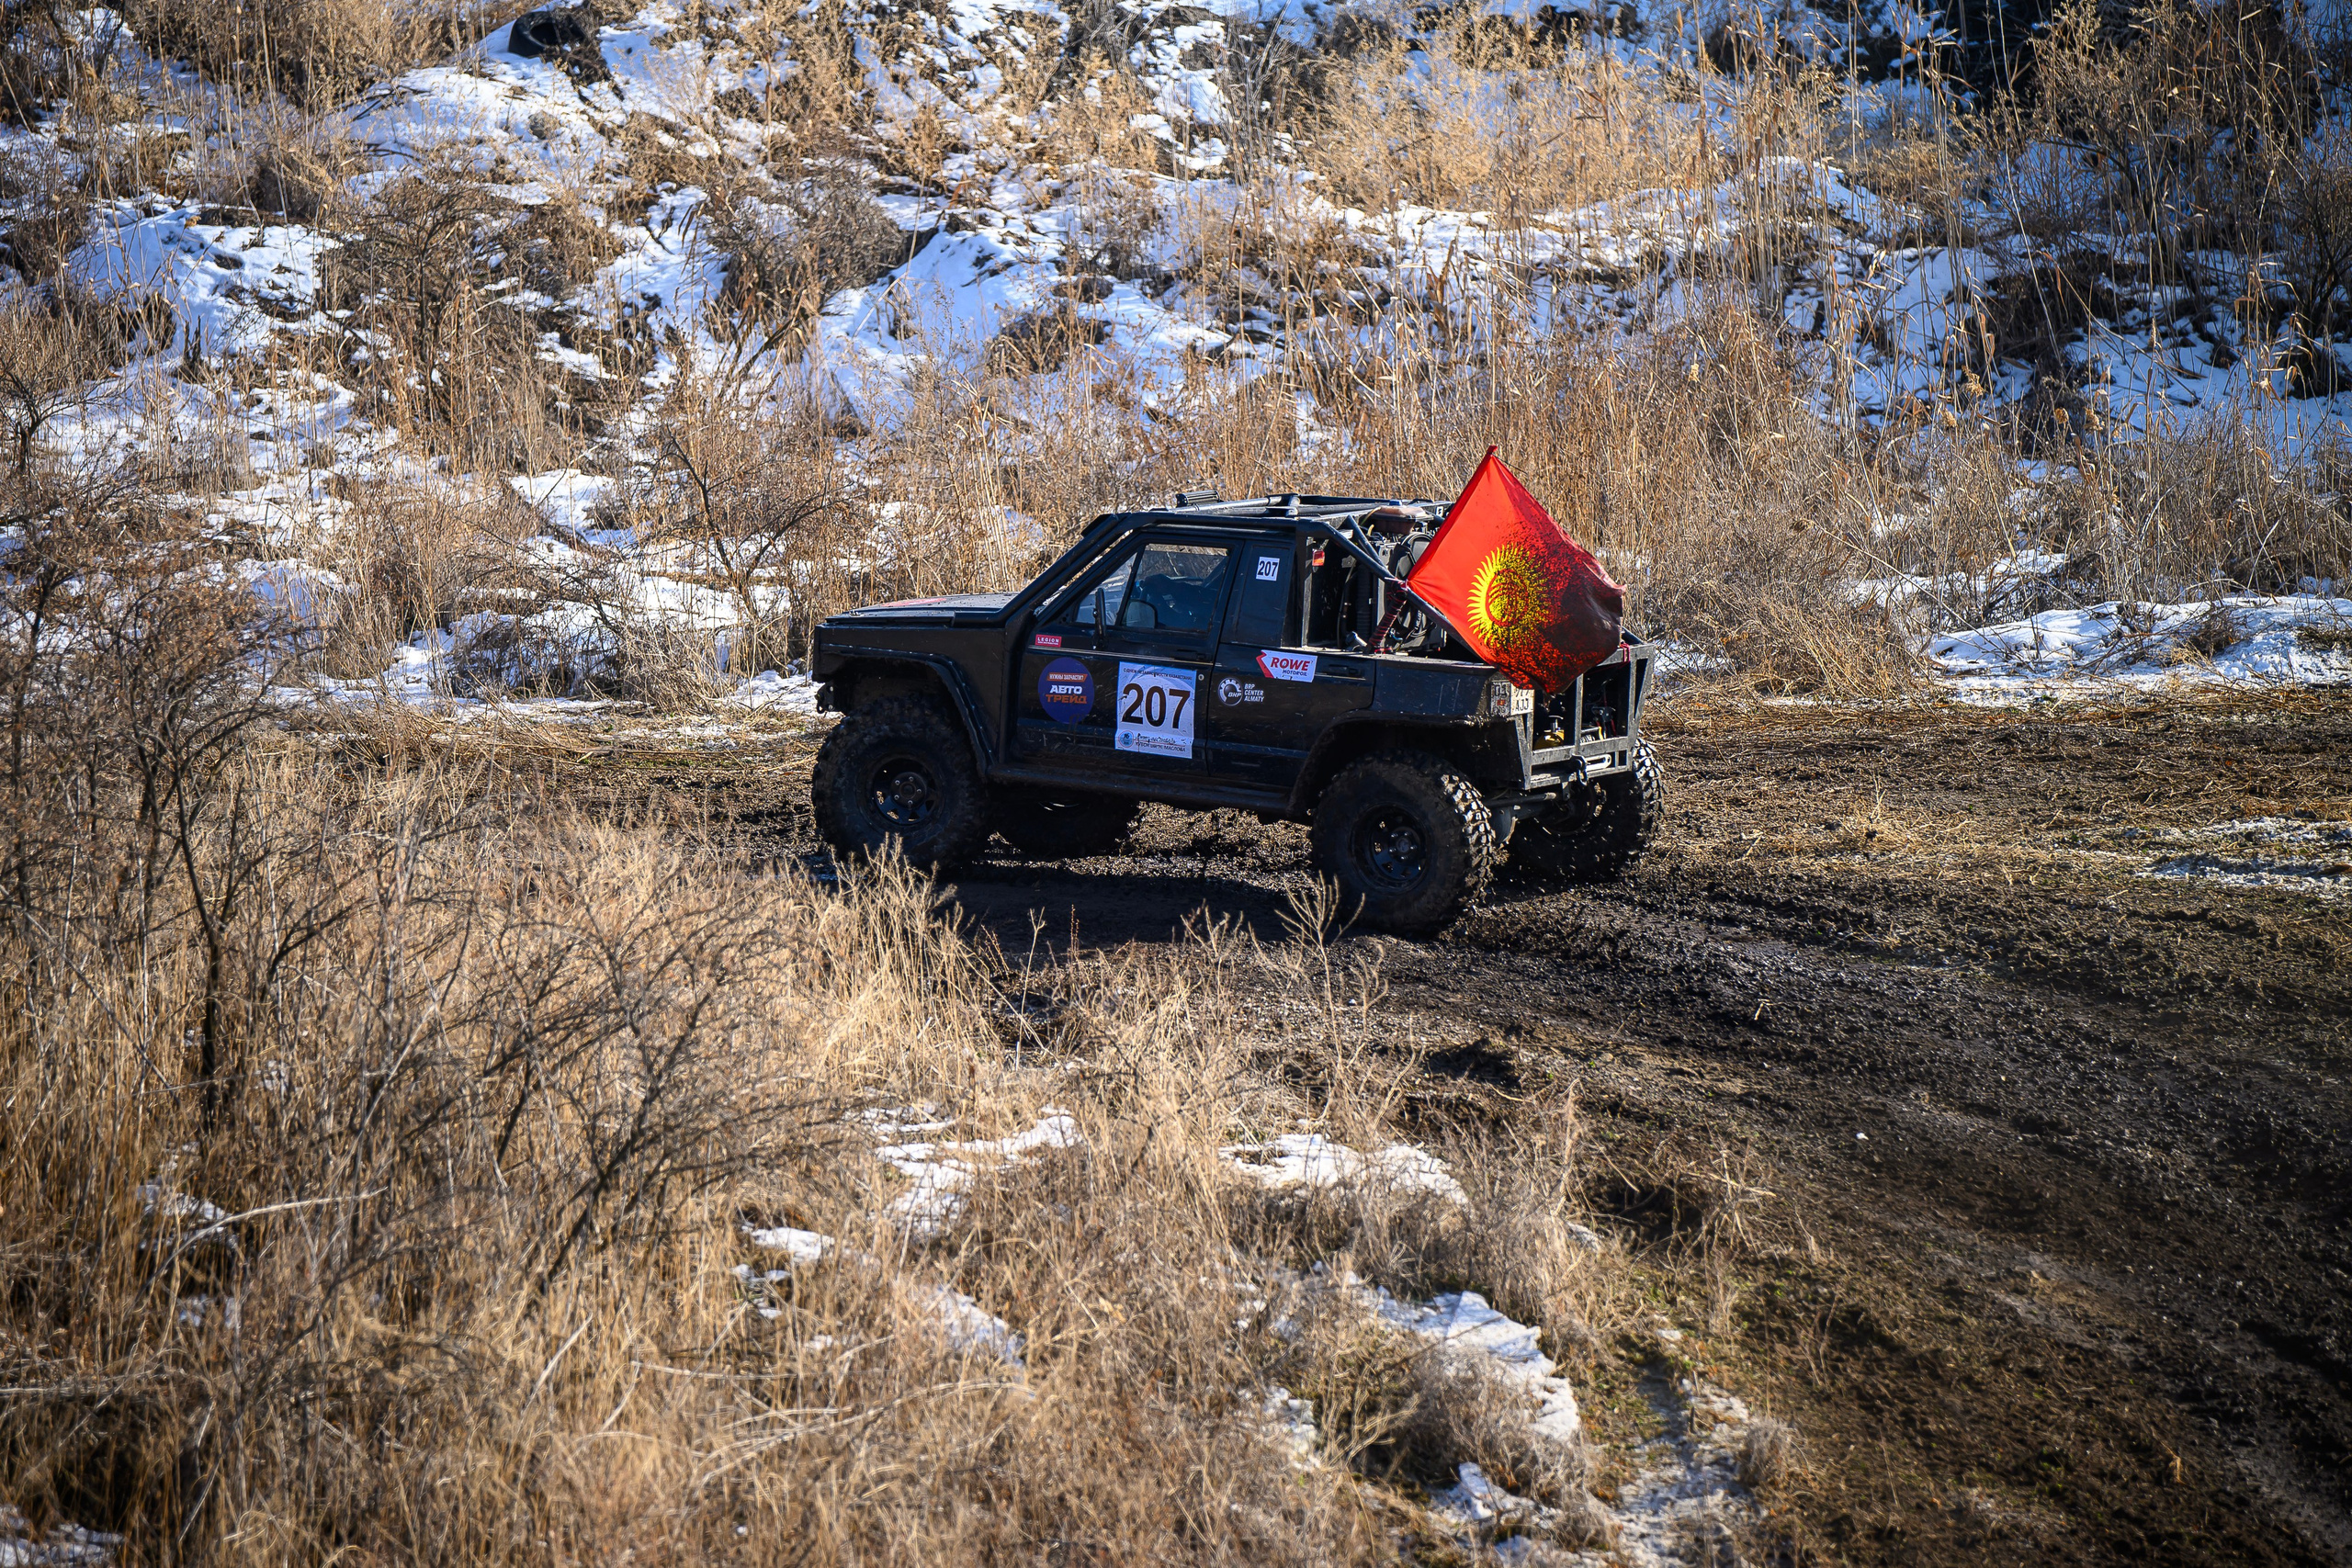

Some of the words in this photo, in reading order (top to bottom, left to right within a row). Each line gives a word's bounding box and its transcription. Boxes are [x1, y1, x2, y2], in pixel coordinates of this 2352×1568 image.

[1258, 560, 1278, 577] 207
[1271, 657, 1310, 671] ROWE
[1049, 684, 1082, 694] АВТО
[1046, 694, 1087, 705] ТРЕЙД
[1121, 682, 1191, 729] 207
